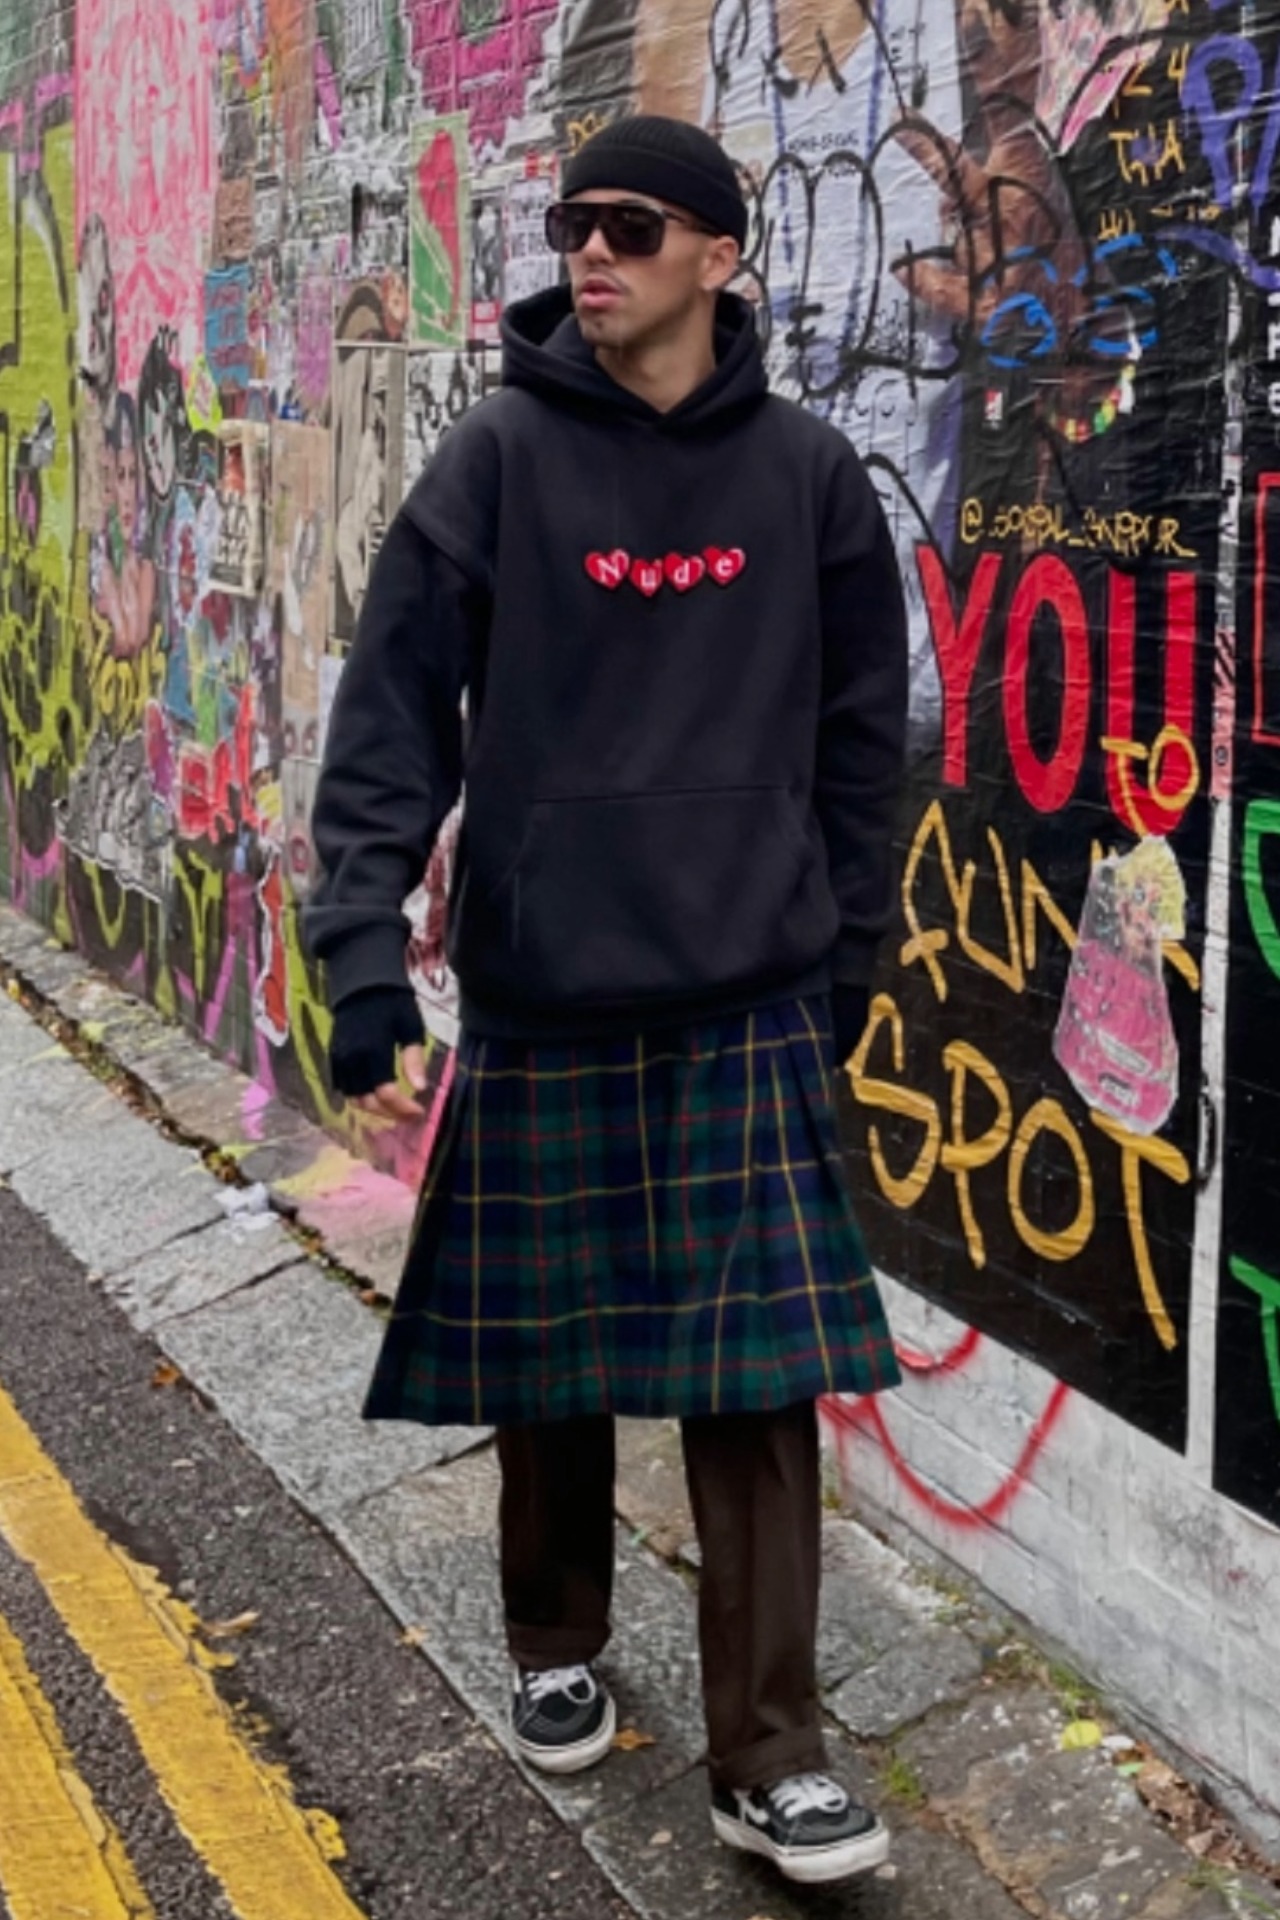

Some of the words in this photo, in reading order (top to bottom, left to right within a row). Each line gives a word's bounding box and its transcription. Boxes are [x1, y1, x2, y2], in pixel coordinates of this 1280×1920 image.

[594, 553, 737, 590] Nude
[915, 545, 1197, 837] YOU
[1100, 723, 1200, 838] TO
[844, 991, 1190, 1351] SPOT
